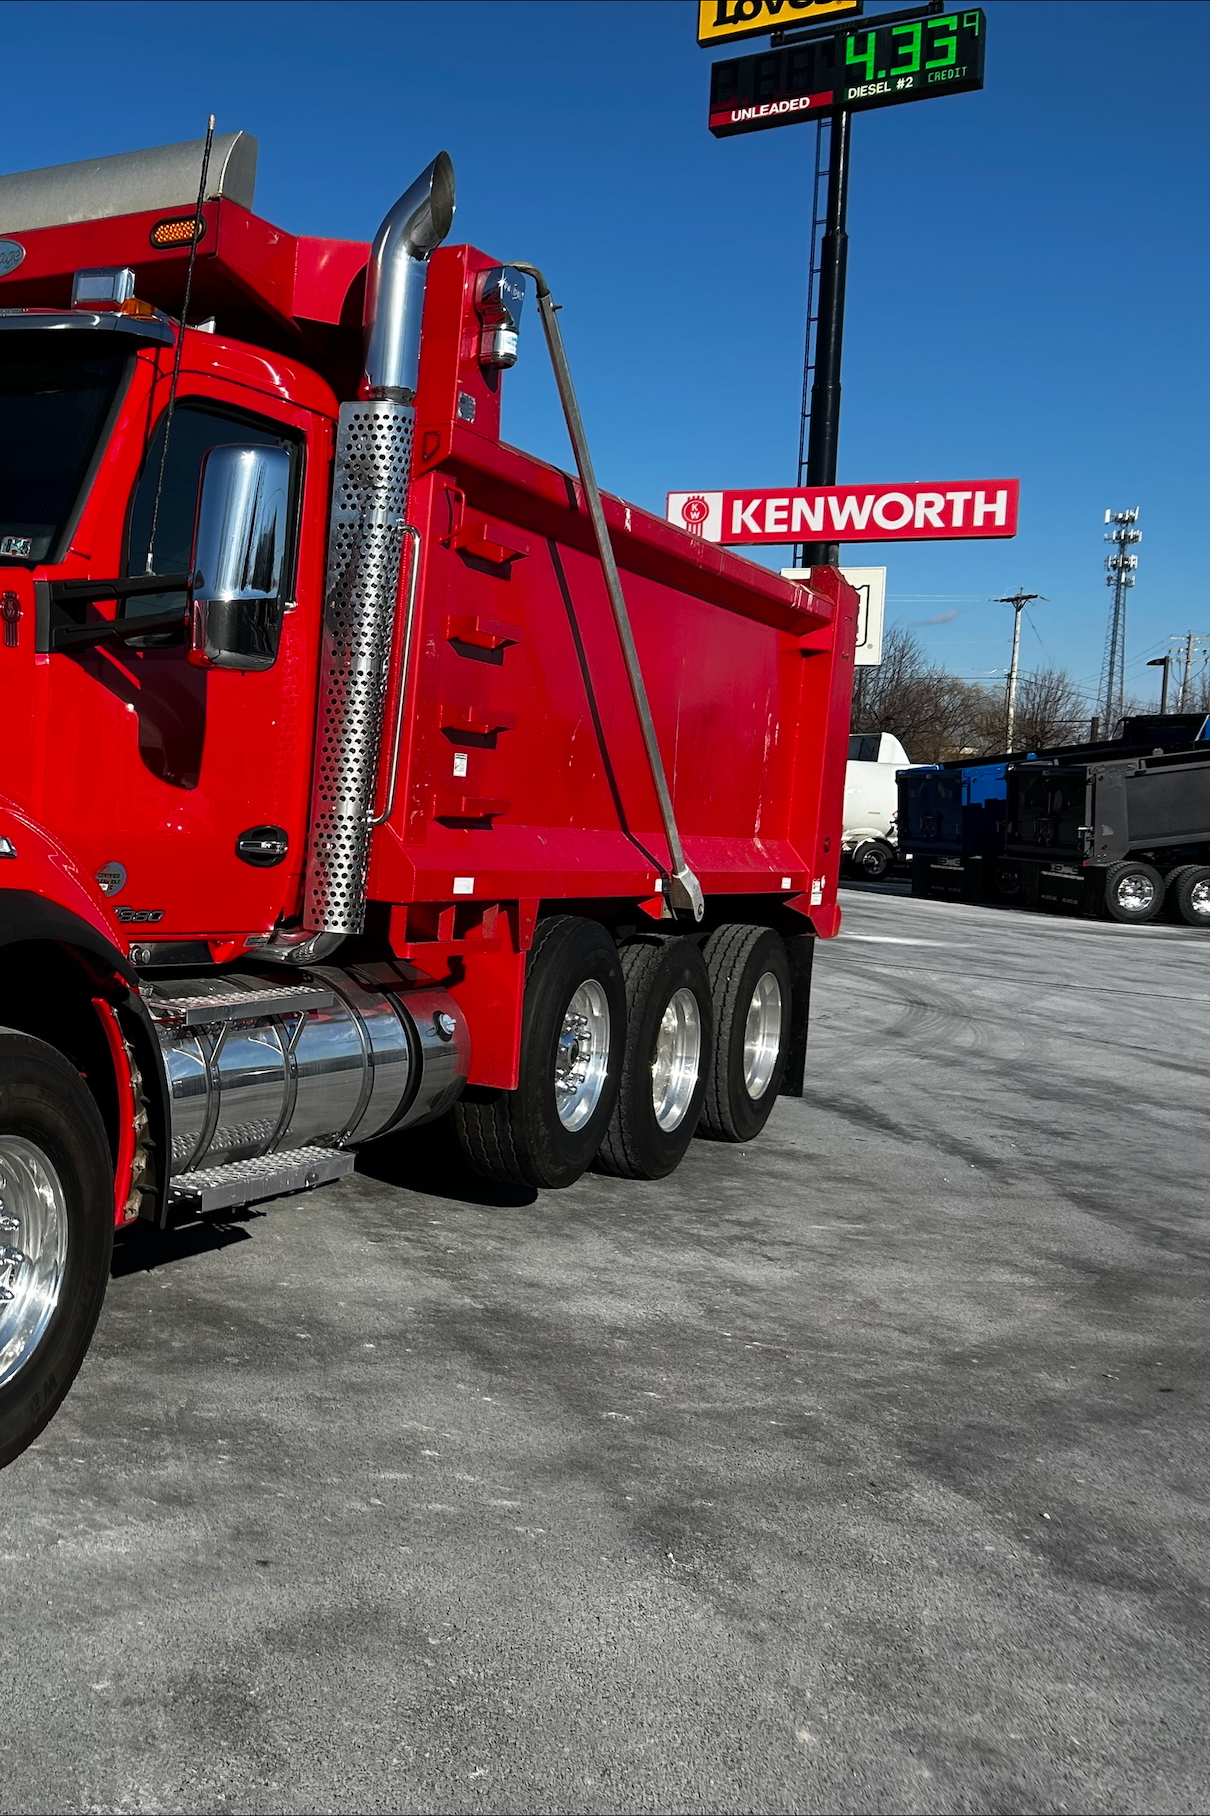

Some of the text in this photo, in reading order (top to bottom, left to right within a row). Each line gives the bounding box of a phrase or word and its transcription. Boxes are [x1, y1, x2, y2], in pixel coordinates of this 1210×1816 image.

[846, 15, 958, 81] 4.33
[928, 66, 967, 83] CREDIT
[848, 76, 914, 99] DIESEL #2
[731, 97, 810, 122] UNLEADED
[731, 490, 1007, 534] KENWORTH
